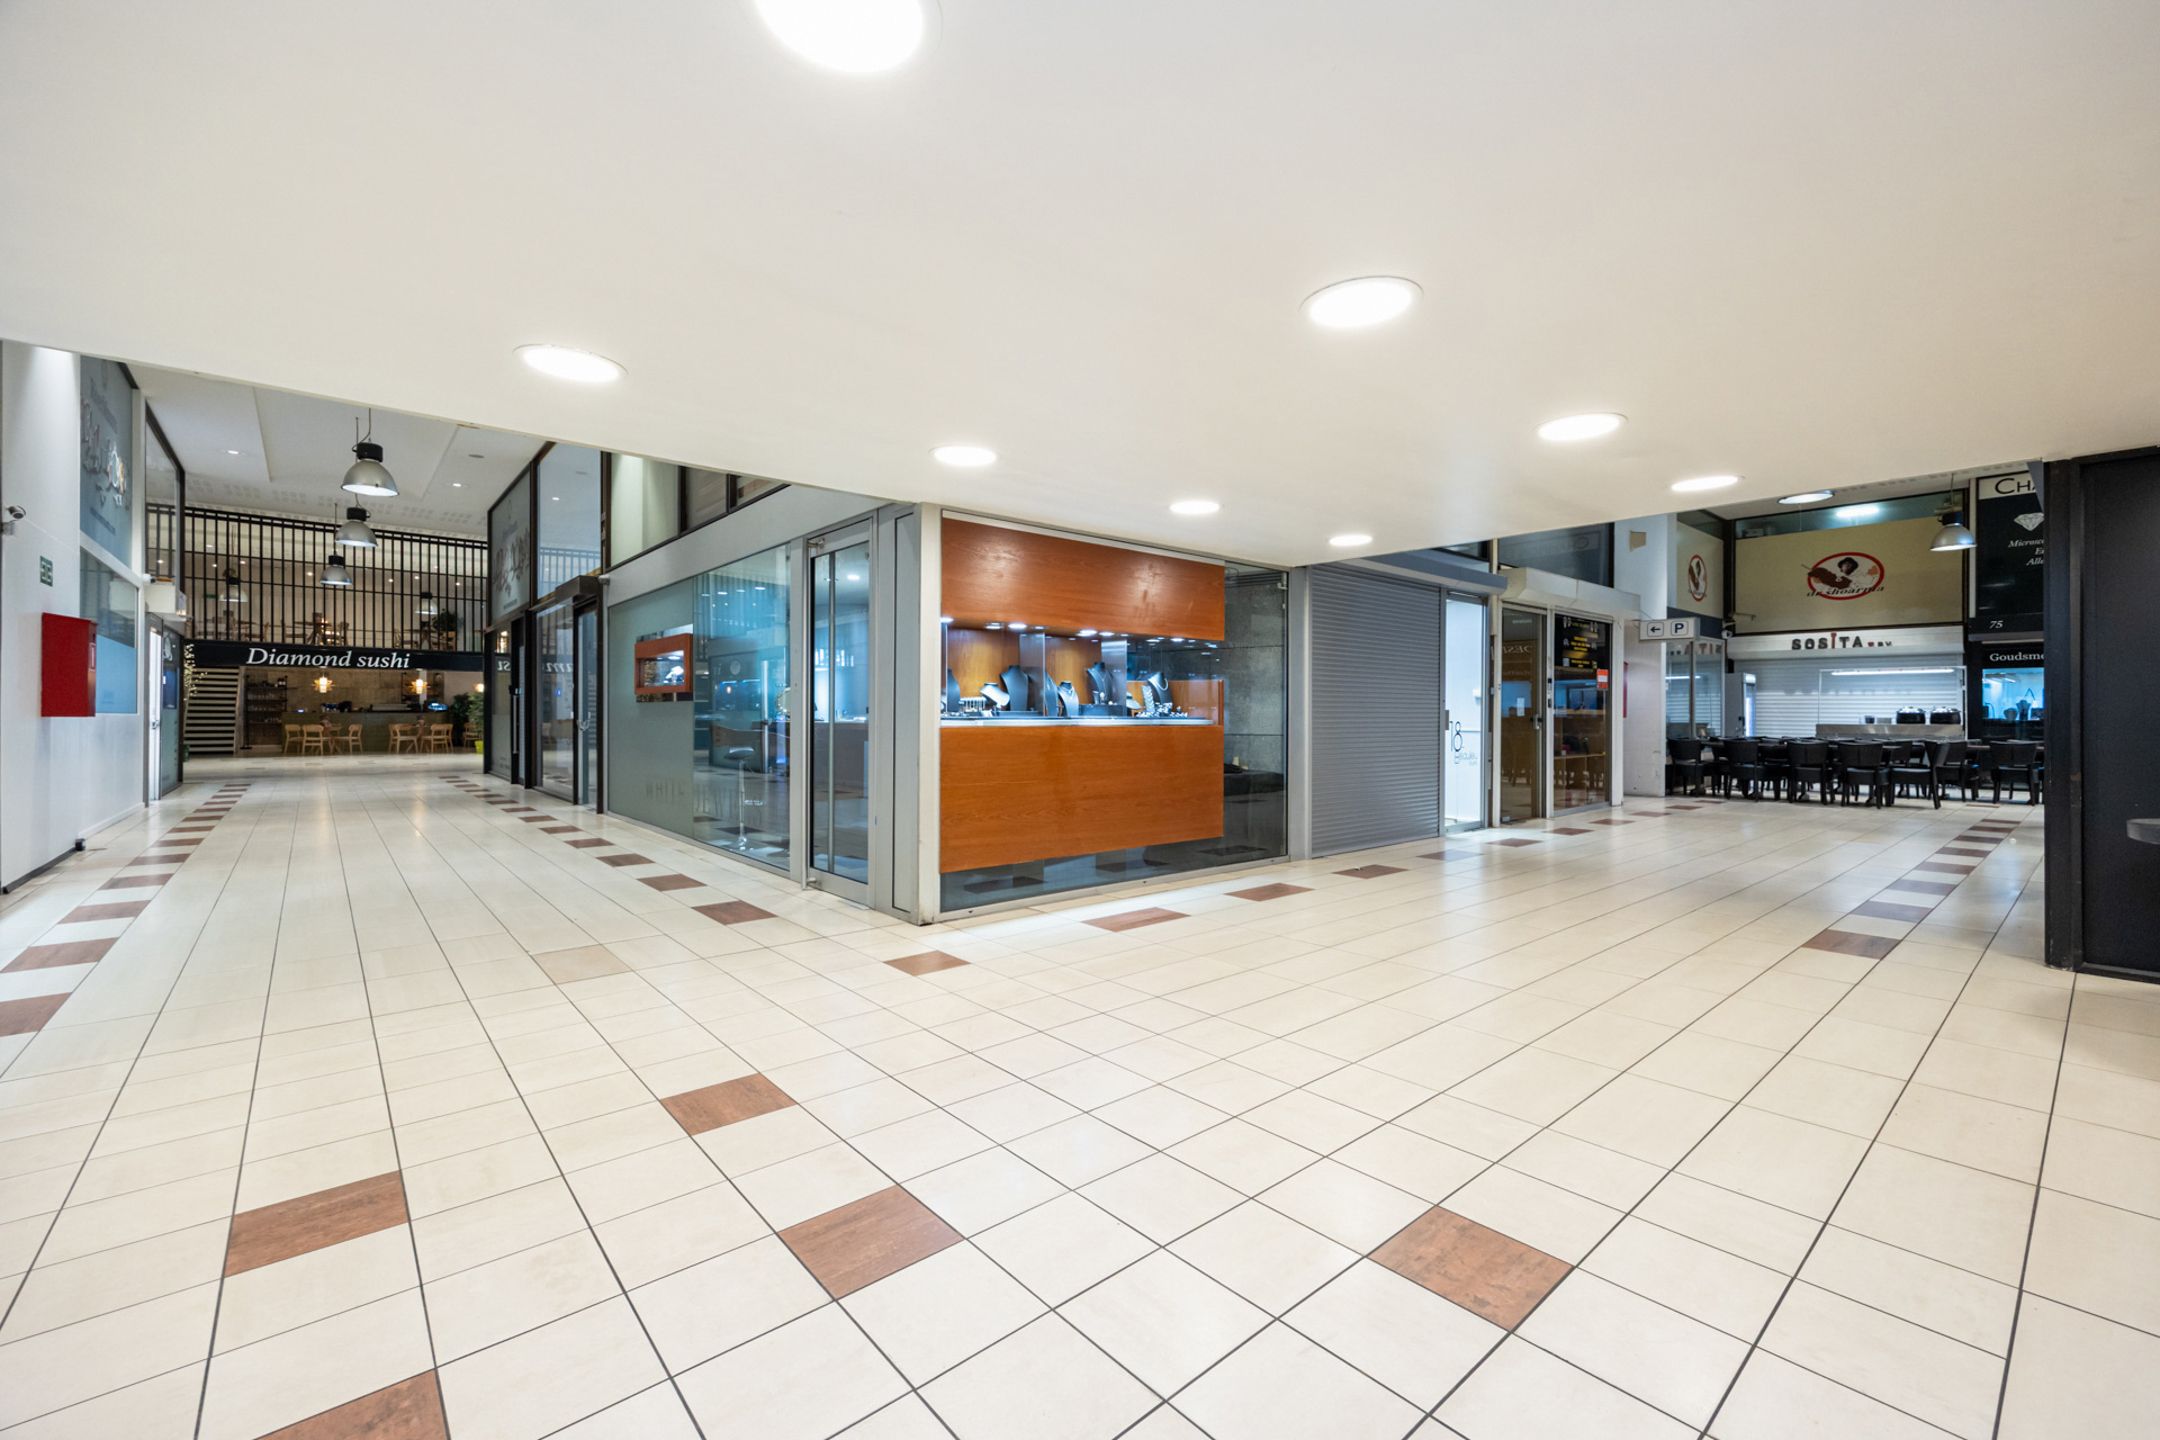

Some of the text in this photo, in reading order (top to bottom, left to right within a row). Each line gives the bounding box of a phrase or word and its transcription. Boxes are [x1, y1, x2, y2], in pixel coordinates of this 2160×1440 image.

[1995, 477, 2036, 494] CH
[1674, 622, 1684, 634] P
[1989, 620, 2004, 629] 75
[1791, 632, 1863, 650] SOSITA
[246, 647, 411, 668] Diamond sushi
